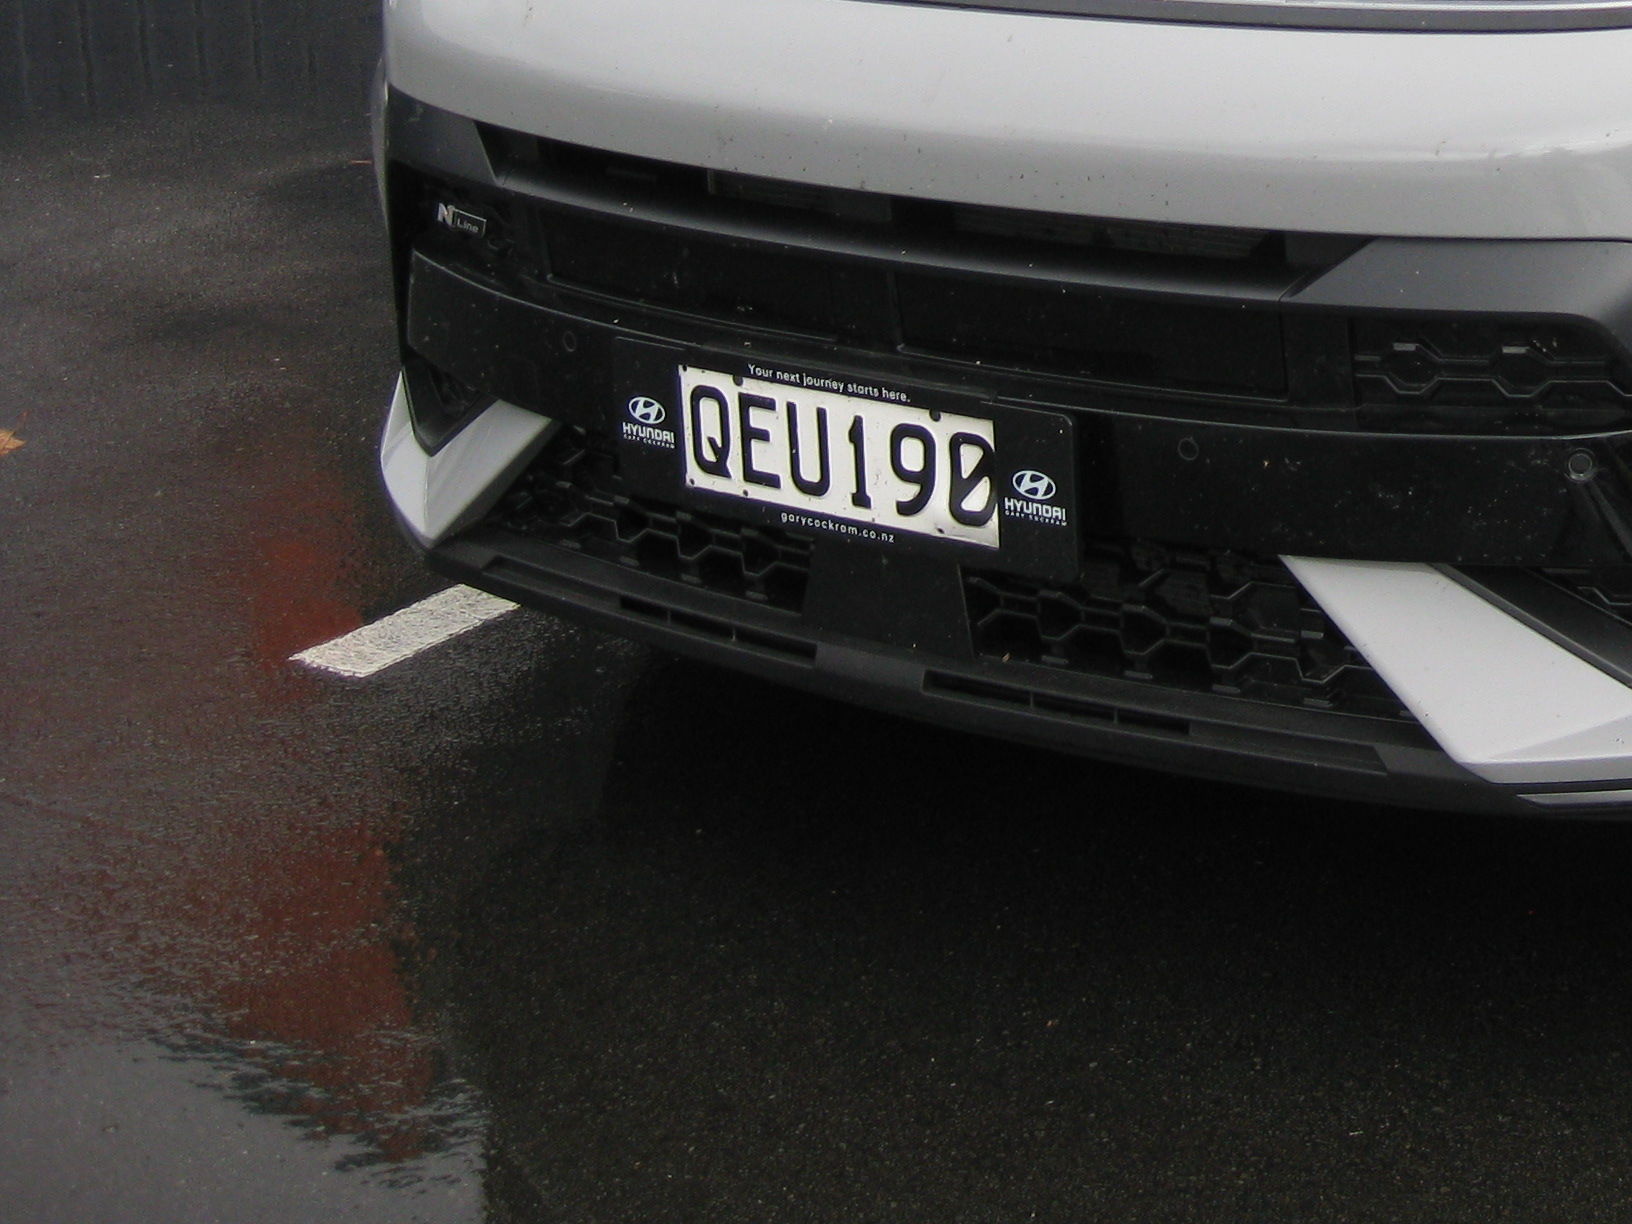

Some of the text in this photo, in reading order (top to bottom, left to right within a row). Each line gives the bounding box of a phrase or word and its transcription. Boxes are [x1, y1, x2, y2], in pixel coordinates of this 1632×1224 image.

[747, 363, 911, 403] Your next journey starts here.
[622, 421, 675, 444] HYUNDAI
[689, 384, 996, 528] QEU190
[1004, 497, 1067, 521] HYUNDAI
[780, 511, 896, 544] garycockram.co.nz
